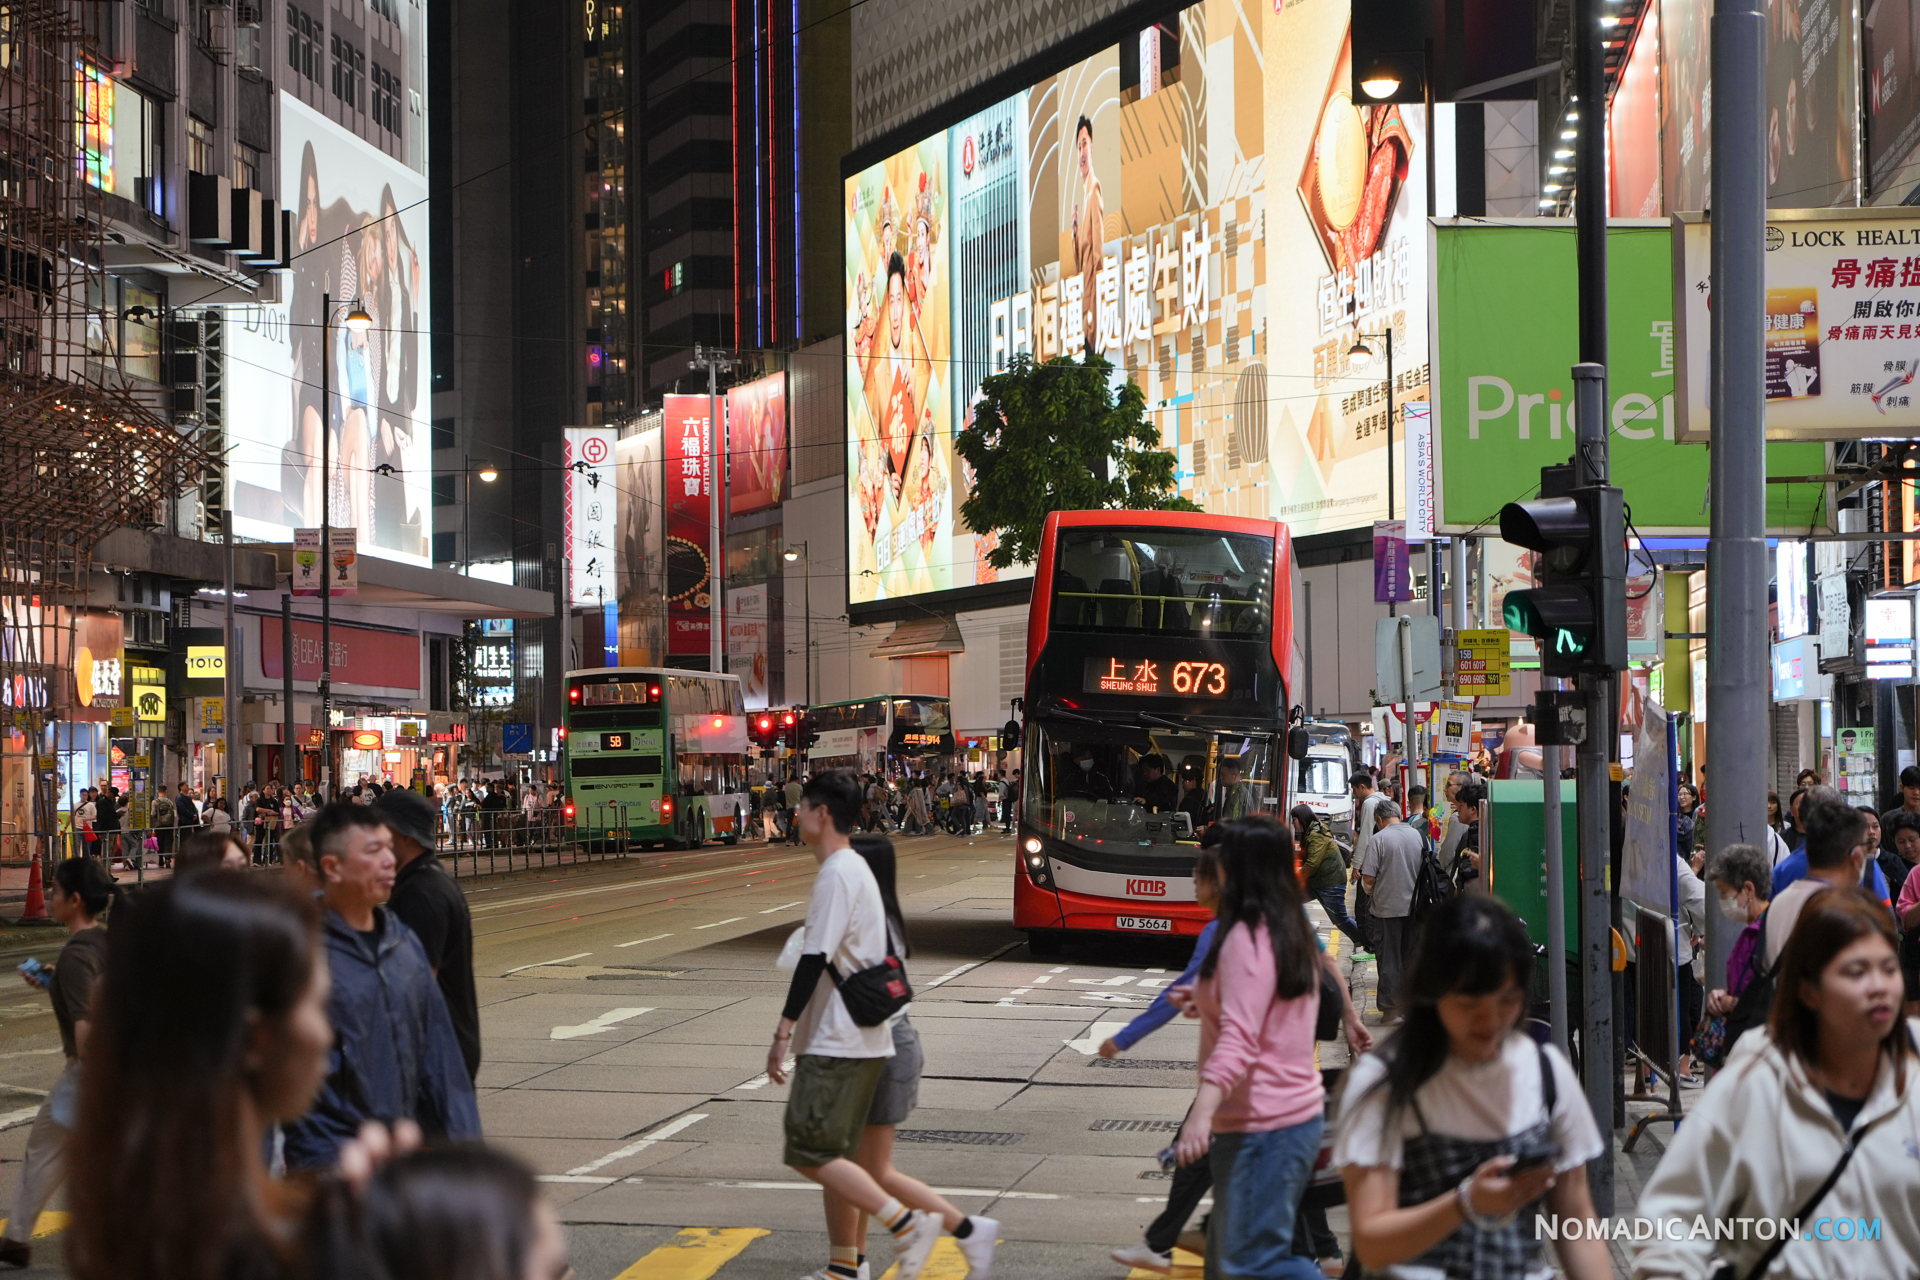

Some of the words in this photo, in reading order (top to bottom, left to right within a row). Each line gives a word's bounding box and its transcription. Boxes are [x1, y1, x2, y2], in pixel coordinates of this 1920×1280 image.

[1792, 230, 1846, 247] LOCK
[1857, 229, 1920, 246] HEALT
[1318, 236, 1410, 337] 恒生迎財神
[1853, 299, 1920, 319] 開啟你
[1883, 360, 1909, 373] 骨膜
[1850, 382, 1875, 394] 筋膜
[1886, 396, 1911, 408] 刺痛
[888, 389, 907, 455] 福
[702, 417, 710, 453] LUKFOOK
[680, 416, 701, 497] 六福珠寶
[702, 454, 711, 496] JEWELLERY
[585, 471, 605, 579] 中國銀行
[1418, 509, 1426, 534] CITY
[1387, 540, 1396, 598] 香港亞洲國際都會
[300, 638, 320, 665] BEA
[474, 645, 511, 668] 周生生
[1459, 649, 1472, 659] 15B
[189, 657, 223, 669] 1010
[1101, 657, 1159, 682] 上水
[1460, 660, 1472, 670] 601
[1473, 660, 1486, 670] 601P
[91, 657, 122, 696] 位元堂
[1101, 681, 1134, 691] SHEUNG
[1136, 682, 1157, 692] SHUI
[1173, 661, 1226, 695] 673
[1459, 674, 1472, 684] 690
[1473, 674, 1486, 684] 690S
[609, 735, 622, 748] 5B
[927, 735, 941, 745] 914
[1125, 878, 1167, 897] KMB
[1120, 917, 1135, 928] VD
[1138, 918, 1168, 930] 5664
